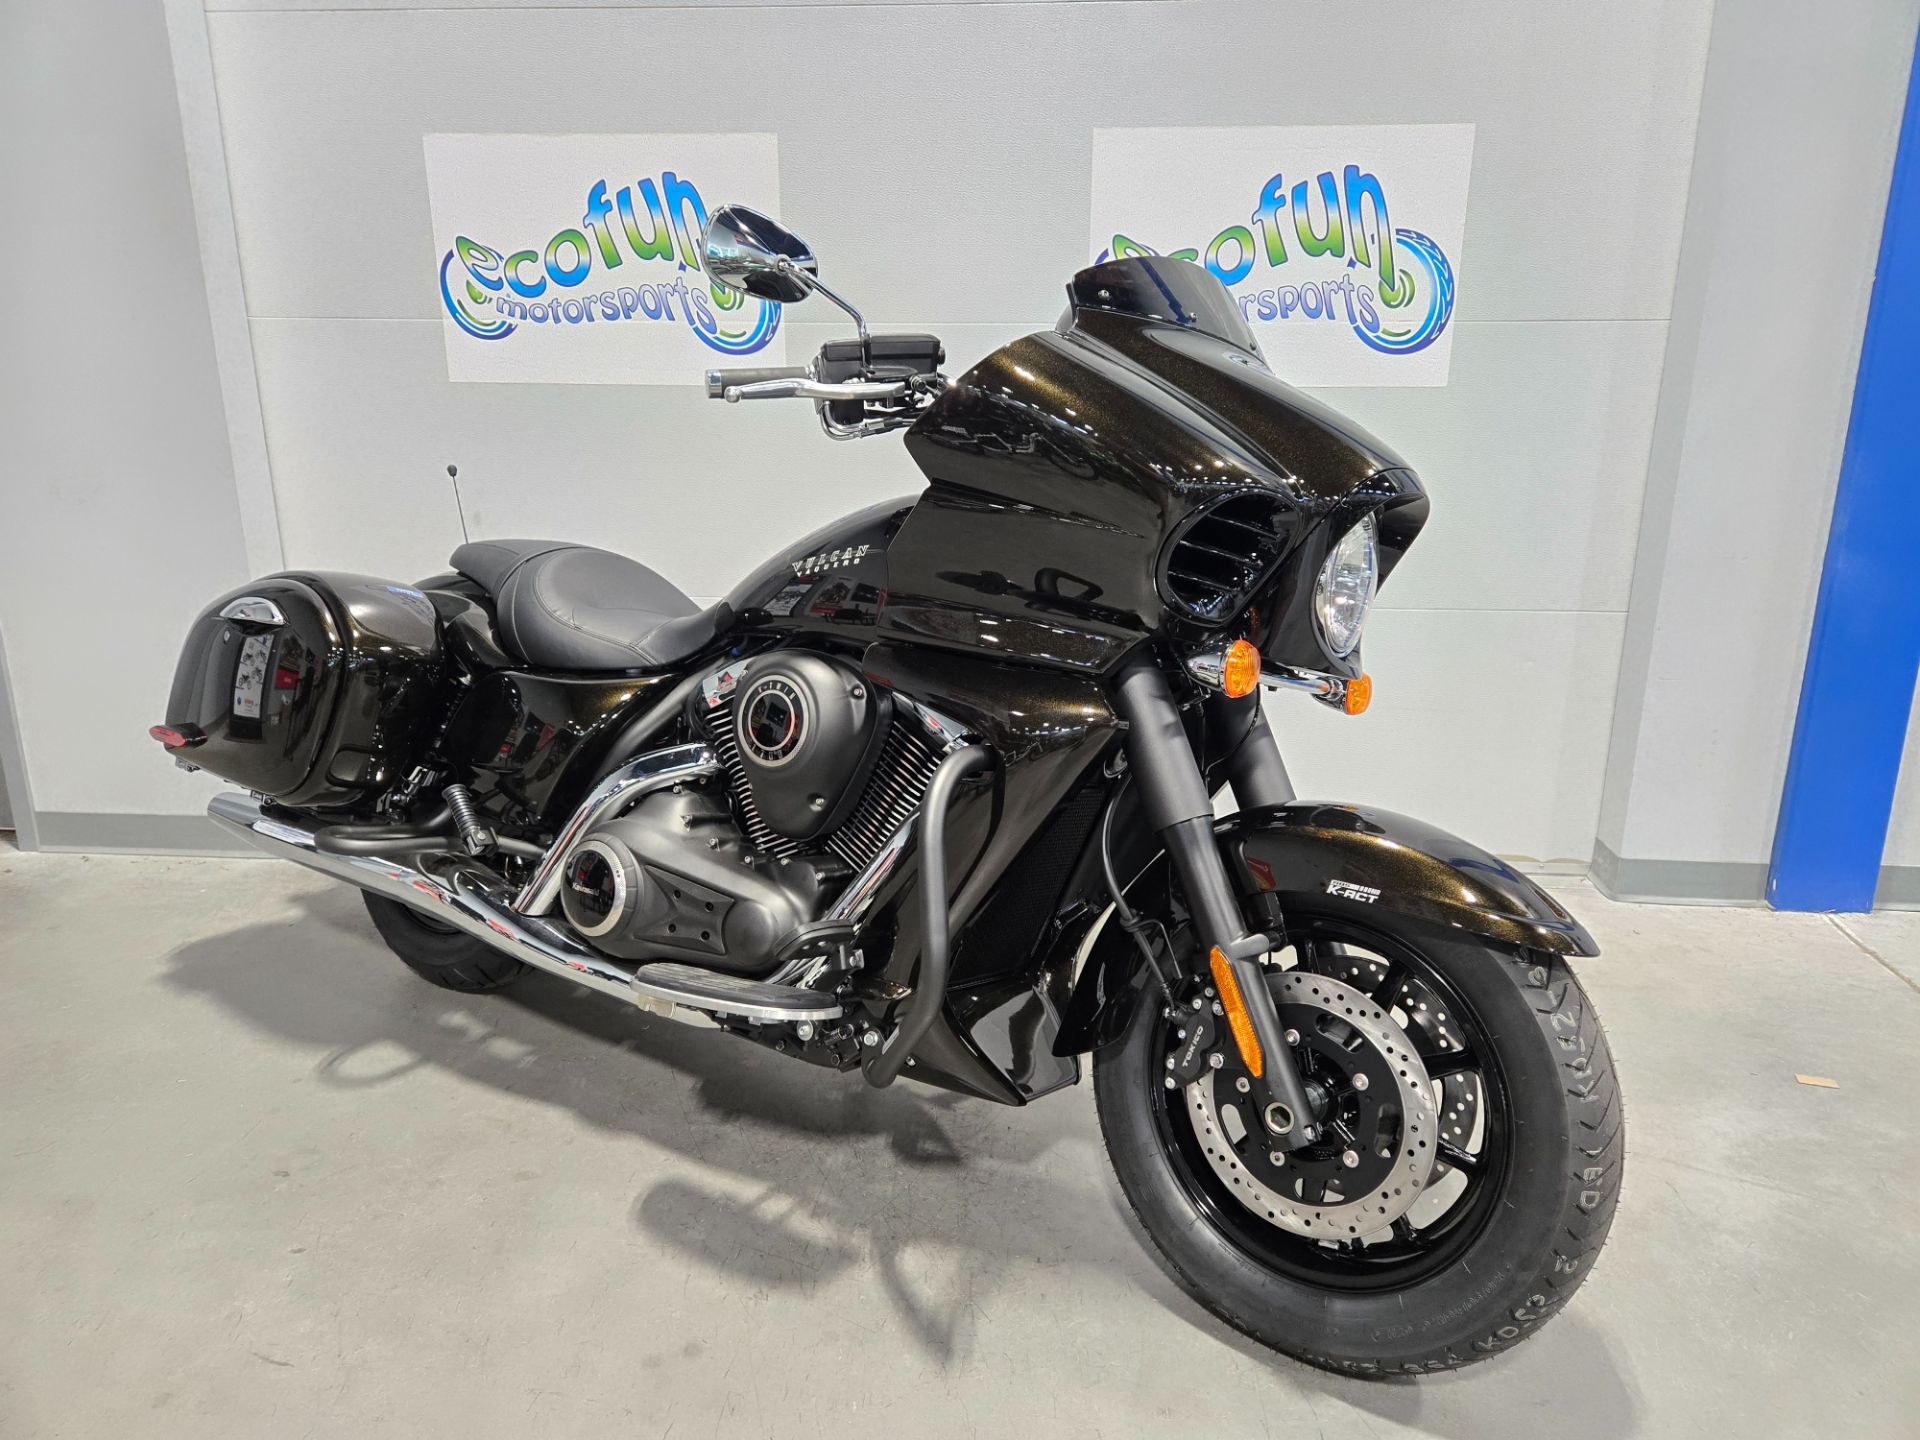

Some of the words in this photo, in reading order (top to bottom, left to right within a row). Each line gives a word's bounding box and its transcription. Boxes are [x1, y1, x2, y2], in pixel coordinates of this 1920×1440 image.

[455, 171, 717, 299] ecofun
[496, 277, 717, 335] motorsports
[792, 545, 870, 572] VULCAN
[796, 558, 860, 578] VAQUERO
[1326, 884, 1379, 904] K-ACT
[1182, 1025, 1204, 1067] TOKICO
